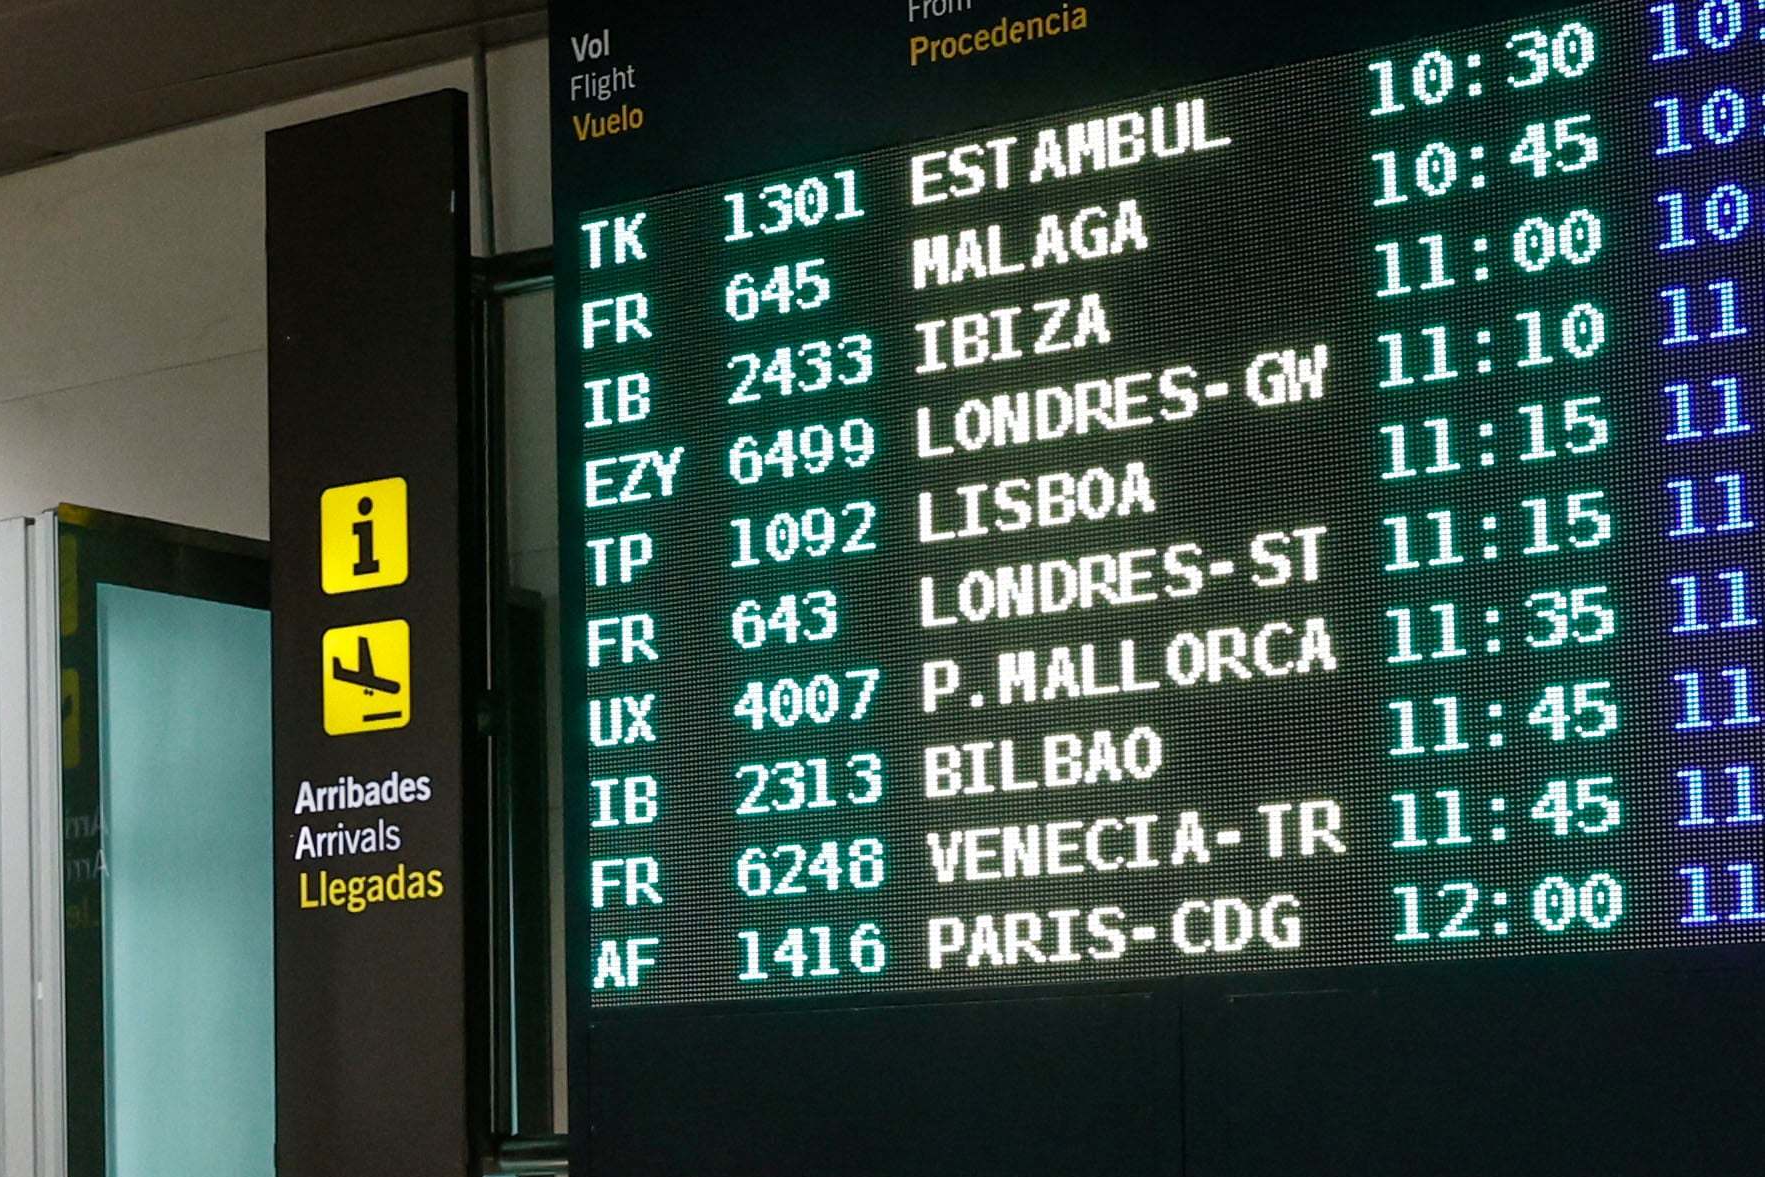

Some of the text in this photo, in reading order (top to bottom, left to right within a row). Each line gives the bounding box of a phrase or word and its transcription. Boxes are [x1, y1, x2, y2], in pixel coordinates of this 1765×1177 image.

[570, 28, 610, 62] Vol
[570, 64, 637, 101] Flight
[910, 3, 1088, 67] Procedencia
[572, 104, 644, 141] Vuelo
[581, 212, 647, 269] TK
[724, 169, 865, 242] 1301
[911, 99, 1232, 206] ESTAMBUL
[1368, 22, 1595, 116] 10:30
[582, 292, 653, 349] FR
[725, 258, 831, 322] 645
[914, 199, 1149, 289] MALAGA
[1372, 113, 1599, 207] 10:45
[584, 372, 651, 428] IB
[727, 334, 874, 405] 2433
[915, 293, 1112, 373] IBIZA
[1375, 209, 1602, 297] 11:00
[585, 281, 1748, 508] EZY 6499 LONDRES-GW 11:10 11
[586, 377, 1751, 586] TP 1092 LISBOA 11:15 11
[588, 474, 1755, 667] FR 643 LONDRES-ST 11:15 11
[589, 571, 1759, 747] UX 4007 P.MALLORCA 11:35 11
[294, 771, 432, 815] Arribades
[591, 668, 1762, 828] IB 2313 BILBAO 11:45 11
[294, 818, 402, 860] Arrivals
[300, 863, 444, 913] Llegadas
[592, 765, 1765, 908] FR 6248 VENECIA-TR 11:45 11
[593, 938, 660, 989] AF
[738, 923, 886, 981] 1416
[929, 894, 1302, 970] PARIS-CDG
[1393, 872, 1624, 943] 12:00
